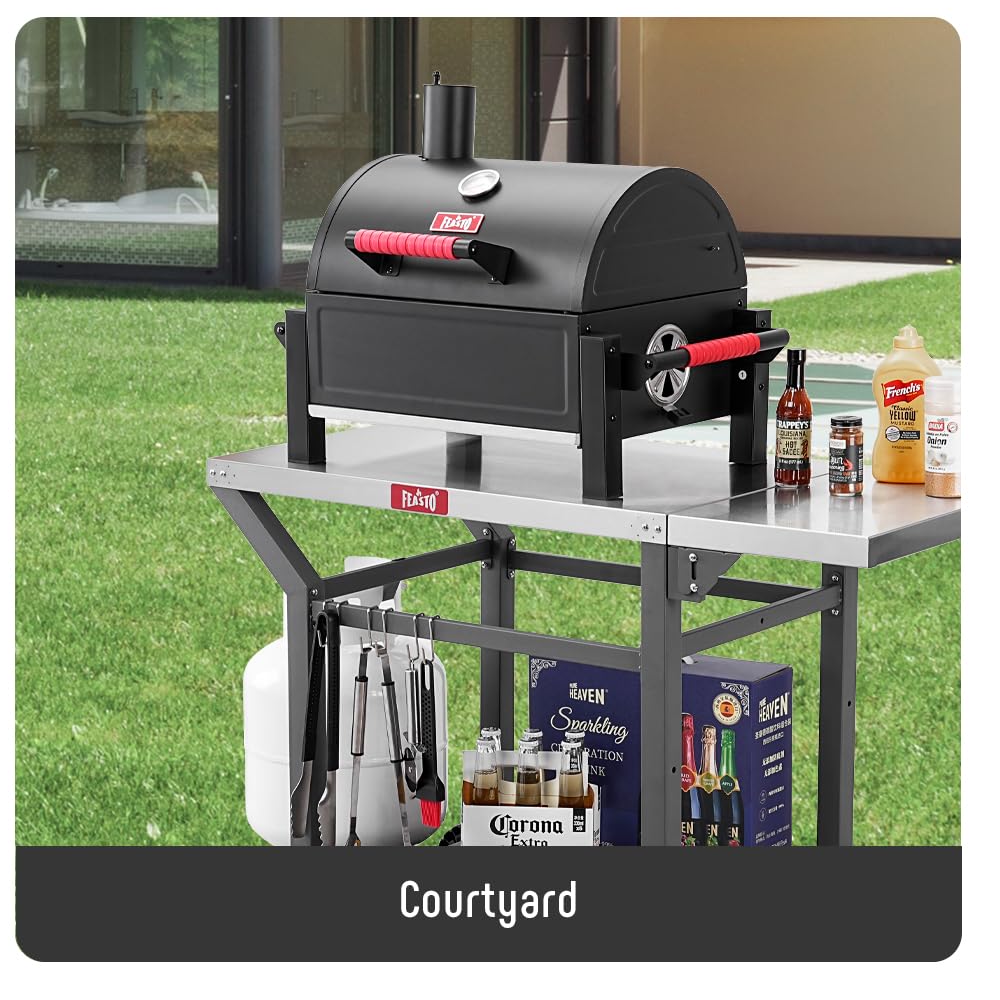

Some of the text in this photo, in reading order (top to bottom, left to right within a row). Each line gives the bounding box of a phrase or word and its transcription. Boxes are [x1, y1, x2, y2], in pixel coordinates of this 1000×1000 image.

[885, 382, 921, 400] French's
[889, 410, 916, 421] YELLOW
[927, 436, 947, 445] Onion
[569, 688, 605, 705] HEAVEN
[758, 692, 788, 723] HEAVEN
[550, 706, 629, 745] Sparkling
[489, 814, 564, 838] Corona
[511, 834, 549, 846] Extra
